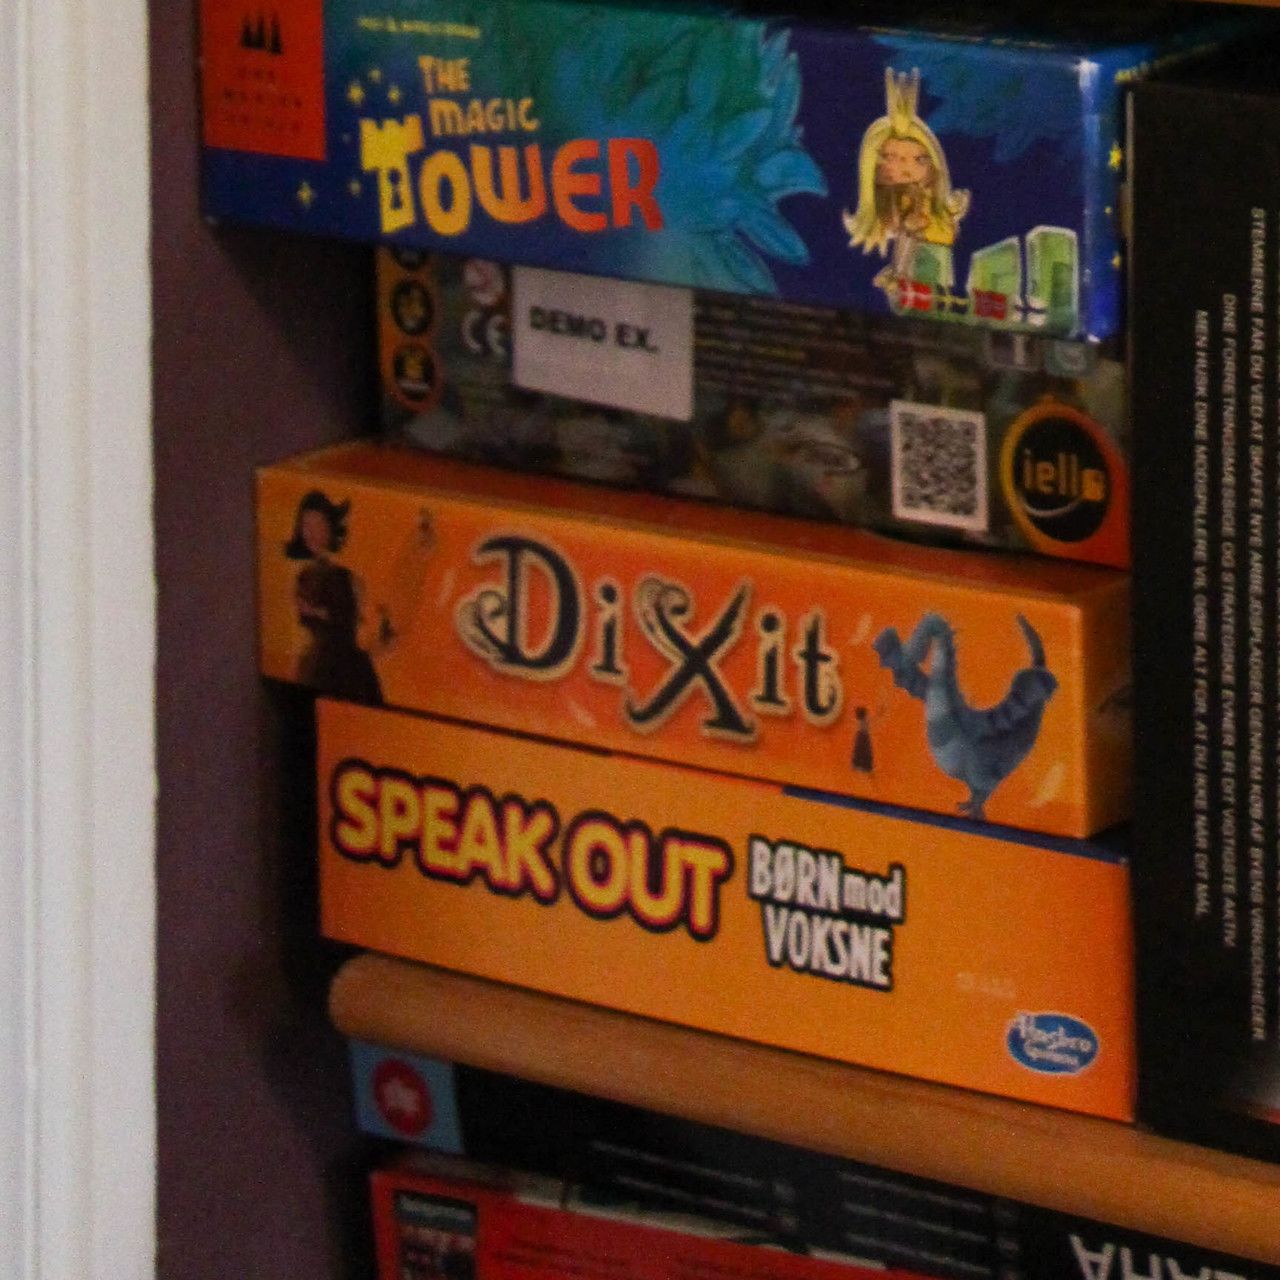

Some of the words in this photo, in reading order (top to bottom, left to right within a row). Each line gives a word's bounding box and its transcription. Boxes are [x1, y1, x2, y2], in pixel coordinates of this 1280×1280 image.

[417, 53, 472, 95] THE
[430, 96, 540, 137] MAGIC
[359, 113, 665, 237] TOWER
[528, 304, 606, 342] DEMO
[332, 759, 558, 901] SPEAK
[567, 814, 731, 938] OUT
[748, 838, 844, 914] BØRN
[841, 863, 903, 920] mod
[764, 903, 892, 987] VOKSNE
